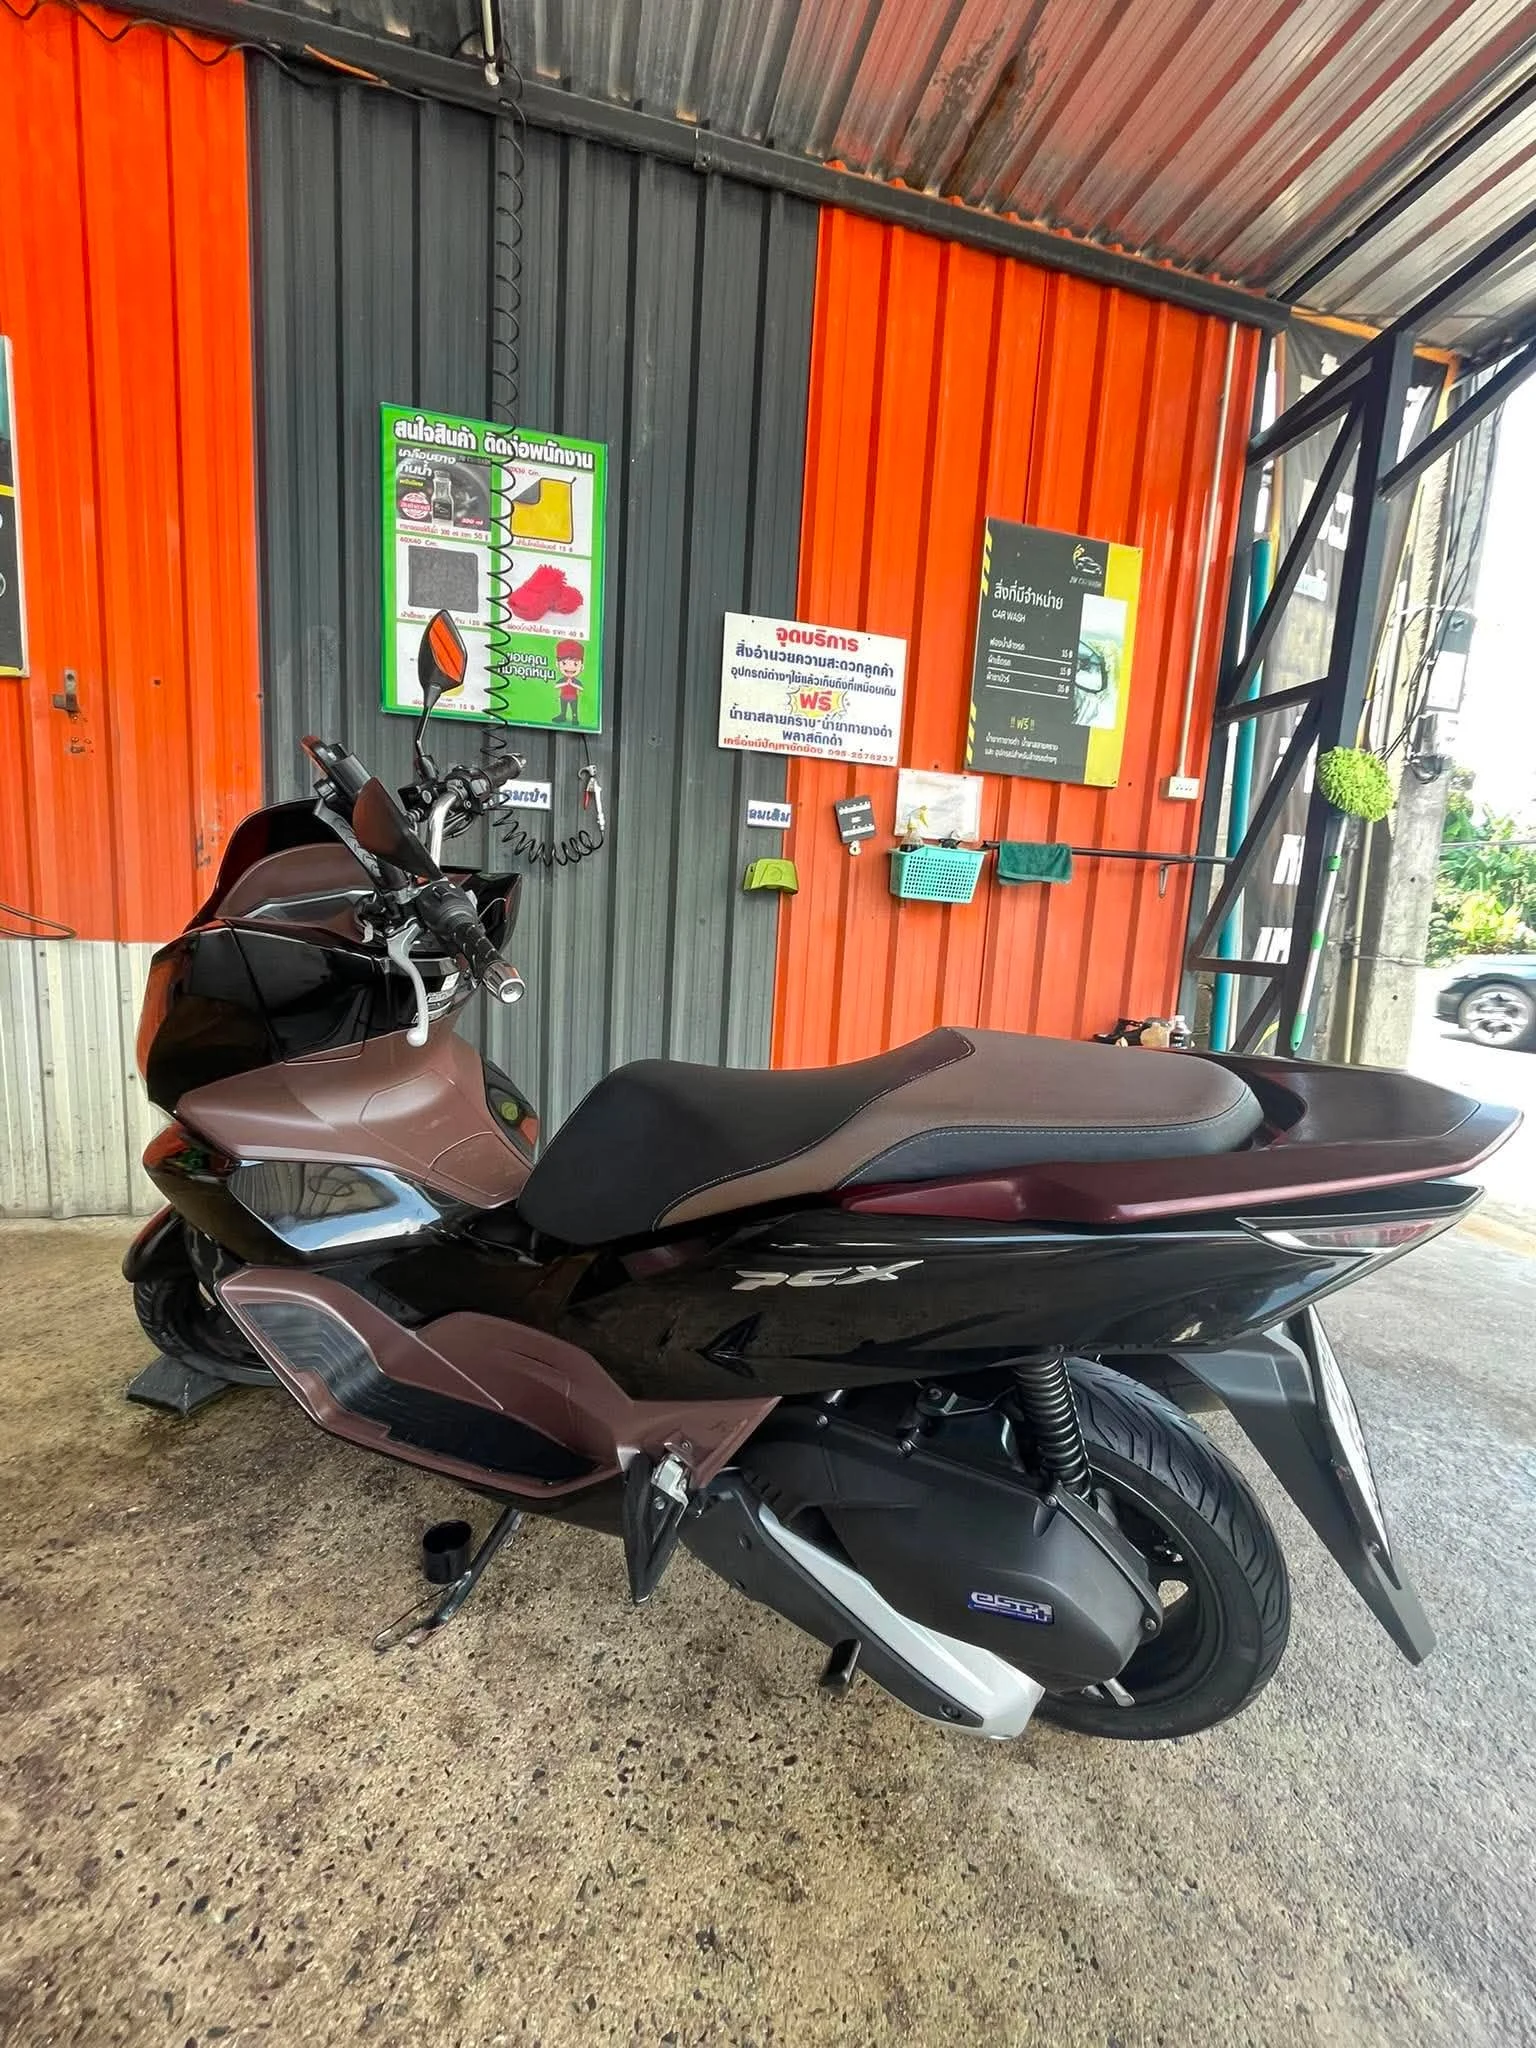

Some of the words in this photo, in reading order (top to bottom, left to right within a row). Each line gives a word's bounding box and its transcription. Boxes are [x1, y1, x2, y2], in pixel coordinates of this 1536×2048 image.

[394, 416, 477, 450] สนใจสินค้า
[484, 432, 593, 469] ติดต่อพนักงาน
[398, 448, 456, 465] เคลือบยาง
[399, 460, 433, 477] กันน้ำ
[994, 578, 1064, 610] สิ่งที่มีจำหน่าย
[992, 608, 1006, 620] CAR
[1006, 611, 1026, 623] WASH
[776, 626, 860, 652] จุดบริการ
[735, 639, 894, 679] สิ่งอำนวยความสะดวกลูกค้า
[799, 690, 833, 712] ฟรี
[782, 729, 843, 747] พลาสติกดำ
[749, 808, 791, 823] ลมเติม
[732, 1260, 924, 1291] PCX
